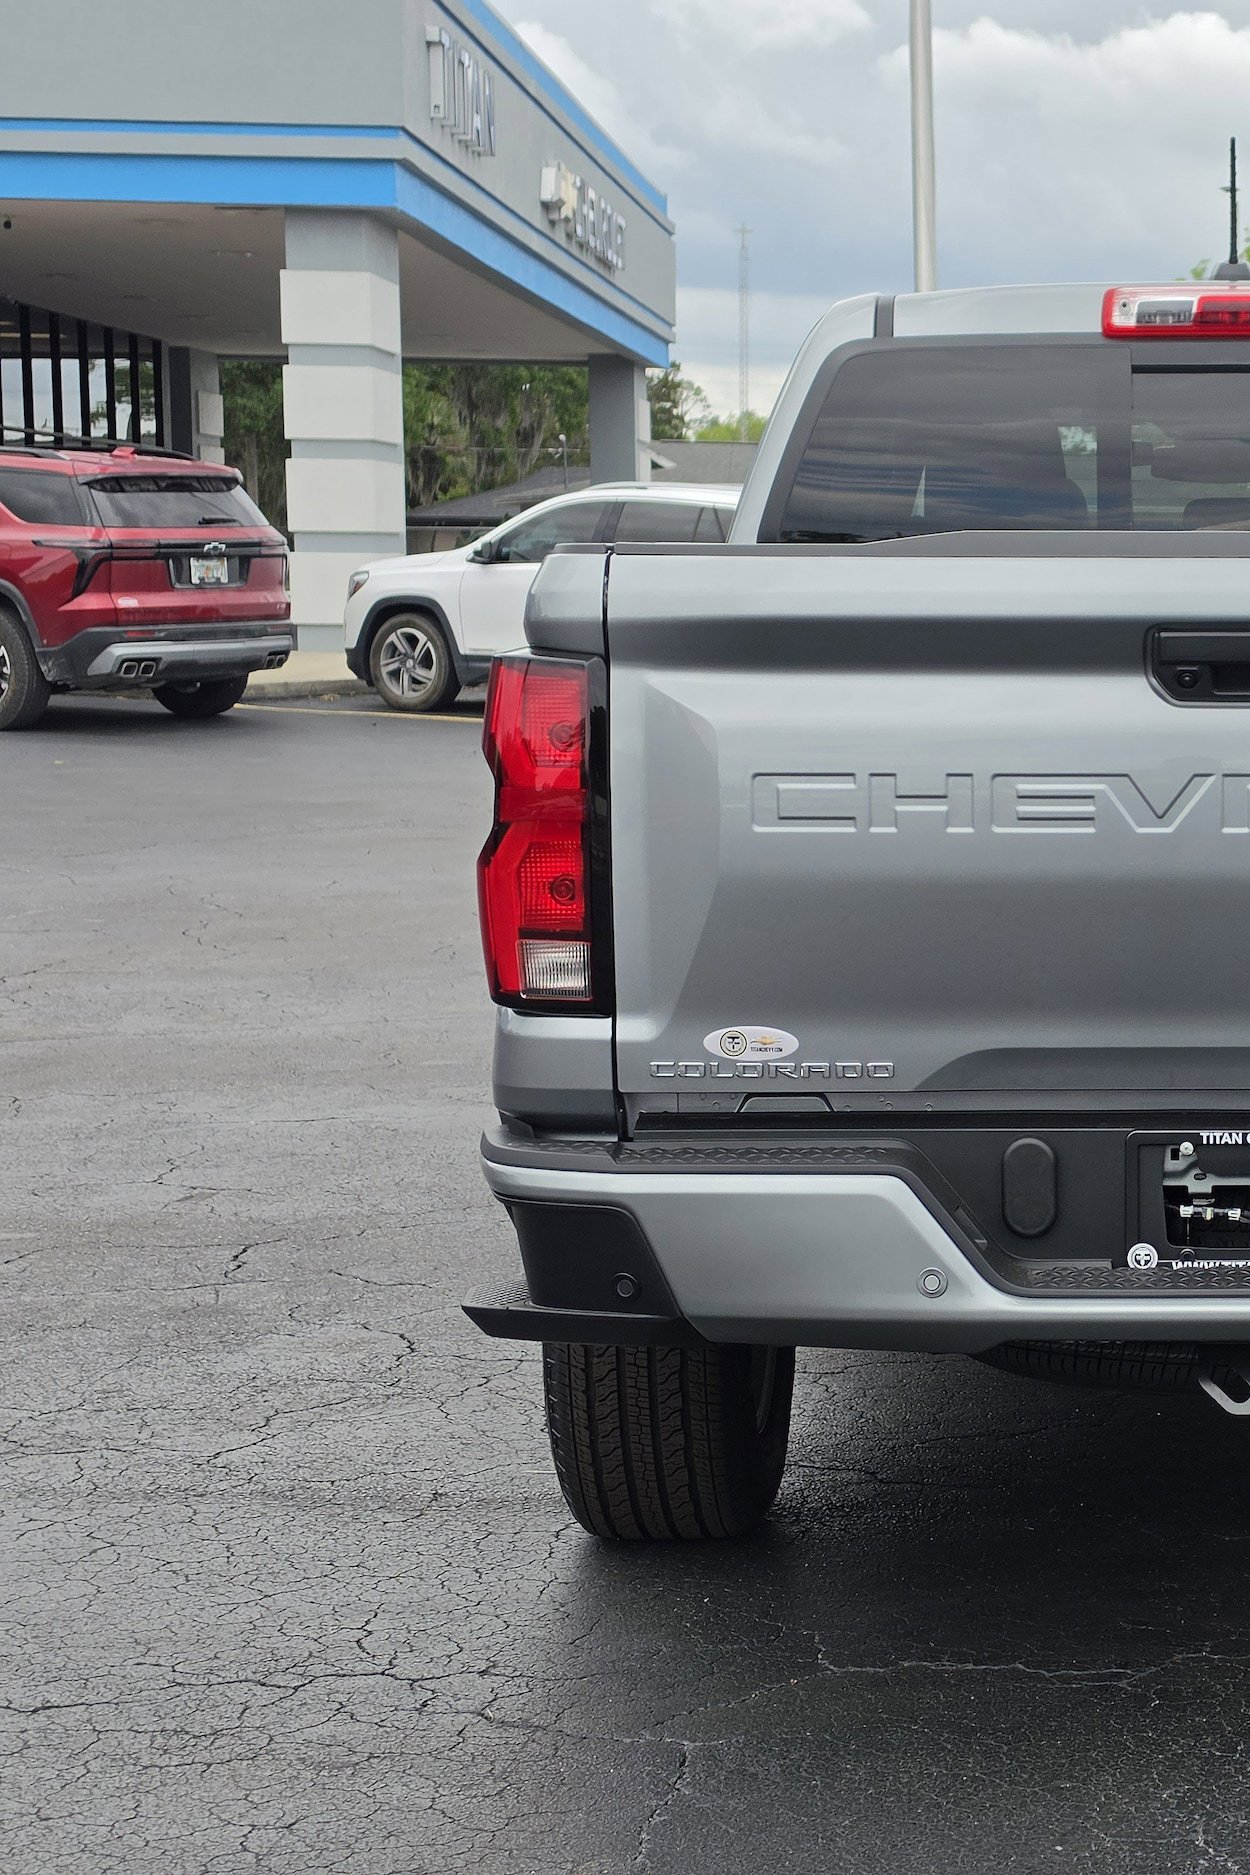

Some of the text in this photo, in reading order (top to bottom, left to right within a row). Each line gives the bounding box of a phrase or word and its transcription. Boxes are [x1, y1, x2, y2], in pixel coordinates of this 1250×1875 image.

[425, 25, 496, 157] TITAN
[649, 1061, 896, 1078] COLORADO
[1199, 1132, 1243, 1145] TITAN
